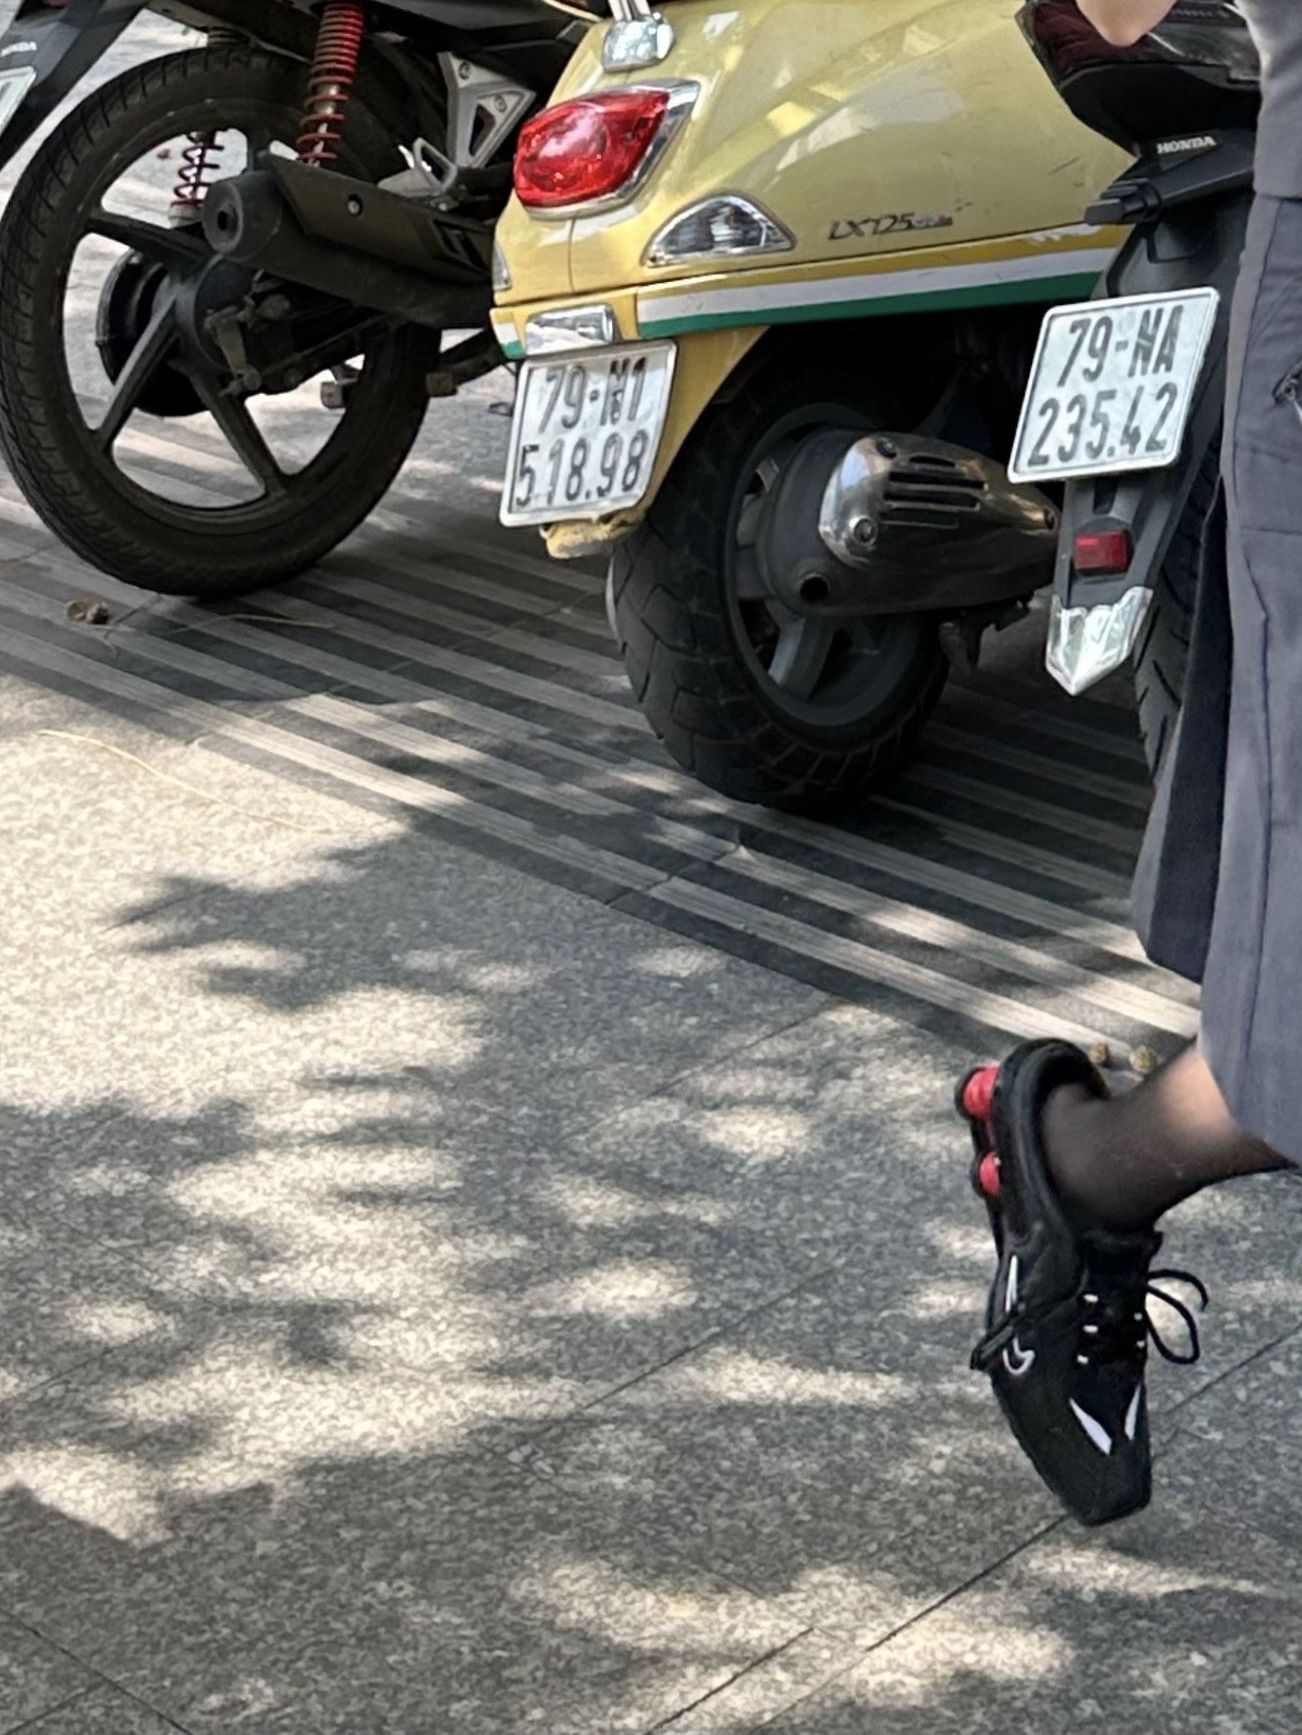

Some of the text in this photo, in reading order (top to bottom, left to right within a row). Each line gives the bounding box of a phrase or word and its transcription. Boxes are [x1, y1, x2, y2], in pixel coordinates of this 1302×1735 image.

[1156, 136, 1217, 154] HONDA
[1057, 305, 1184, 387] 79-NA
[1028, 381, 1178, 467] 235.42
[516, 429, 649, 507] 518.98
